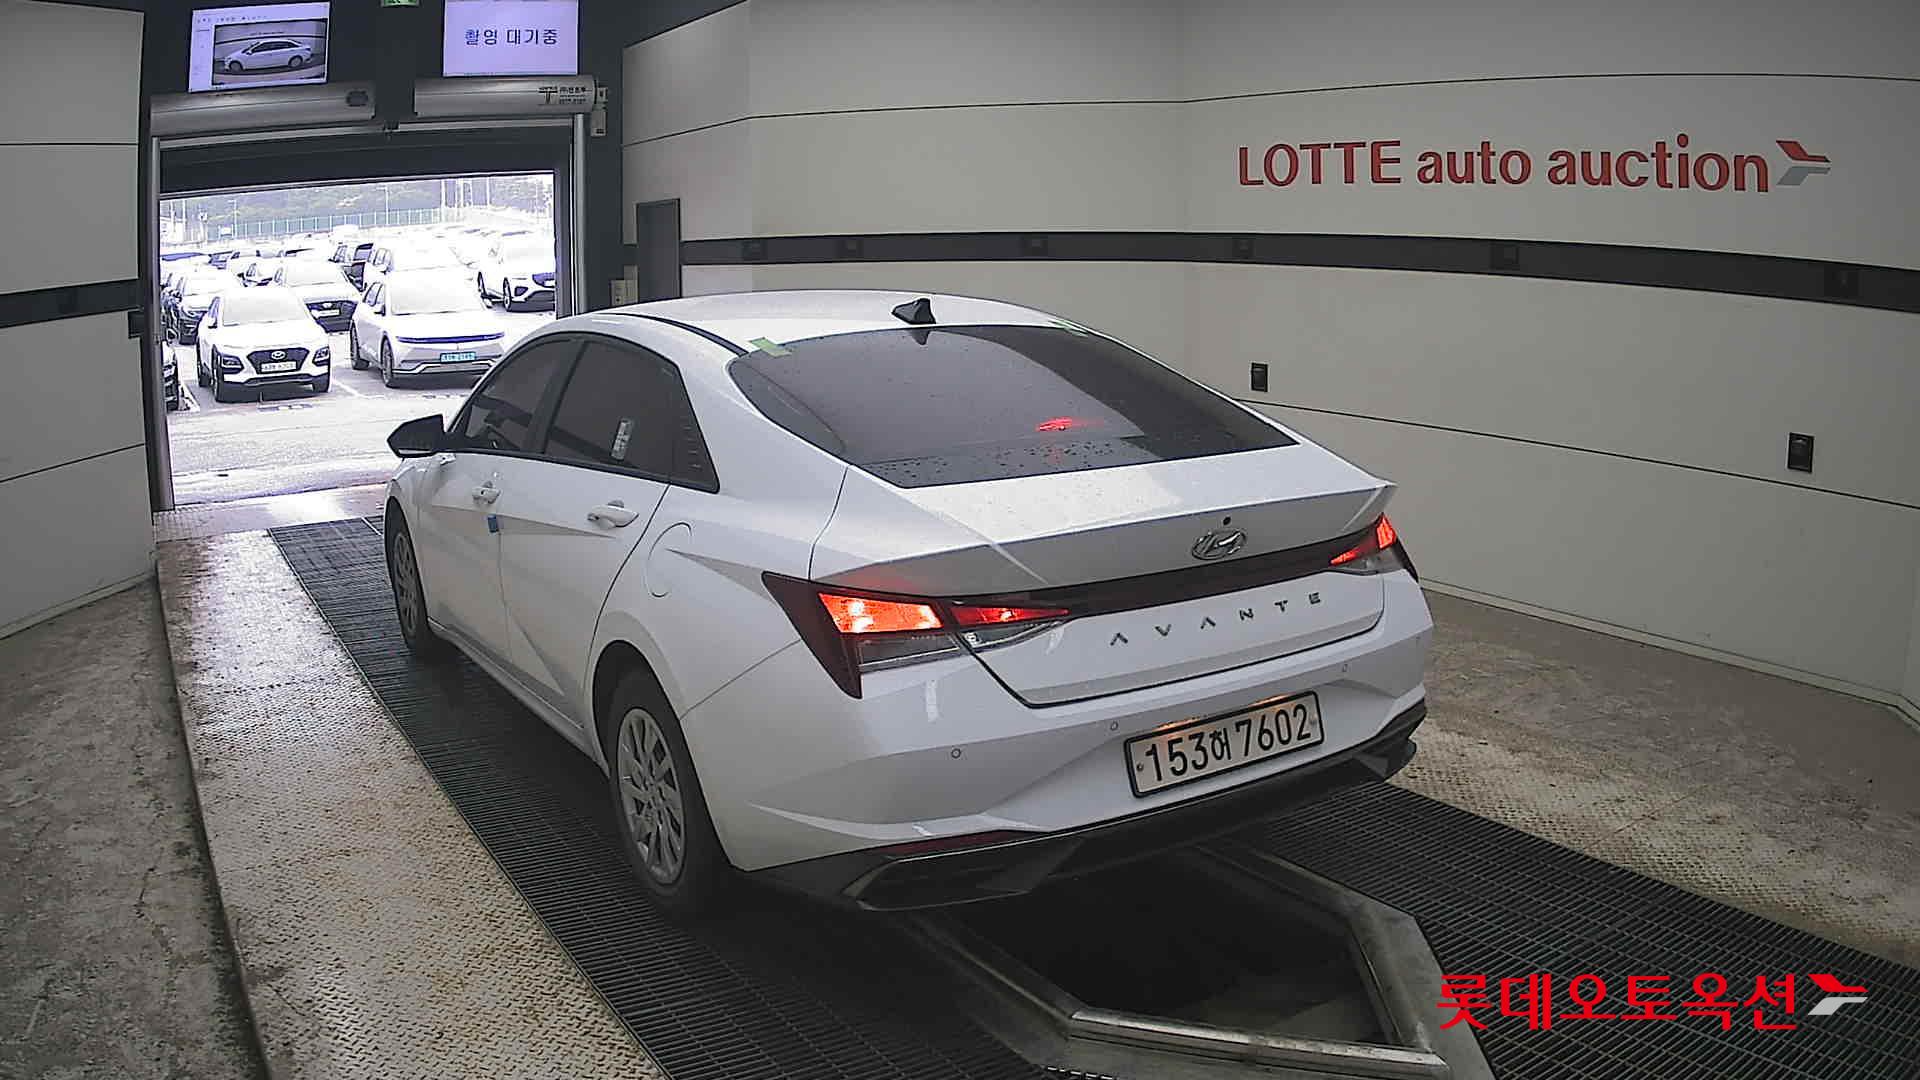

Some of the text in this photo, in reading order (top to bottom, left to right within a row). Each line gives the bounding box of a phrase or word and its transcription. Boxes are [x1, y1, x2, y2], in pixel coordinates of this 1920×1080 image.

[506, 29, 557, 45] 대기중
[1240, 133, 1770, 194] LOTTE auto auction
[1109, 591, 1322, 647] AVANTE
